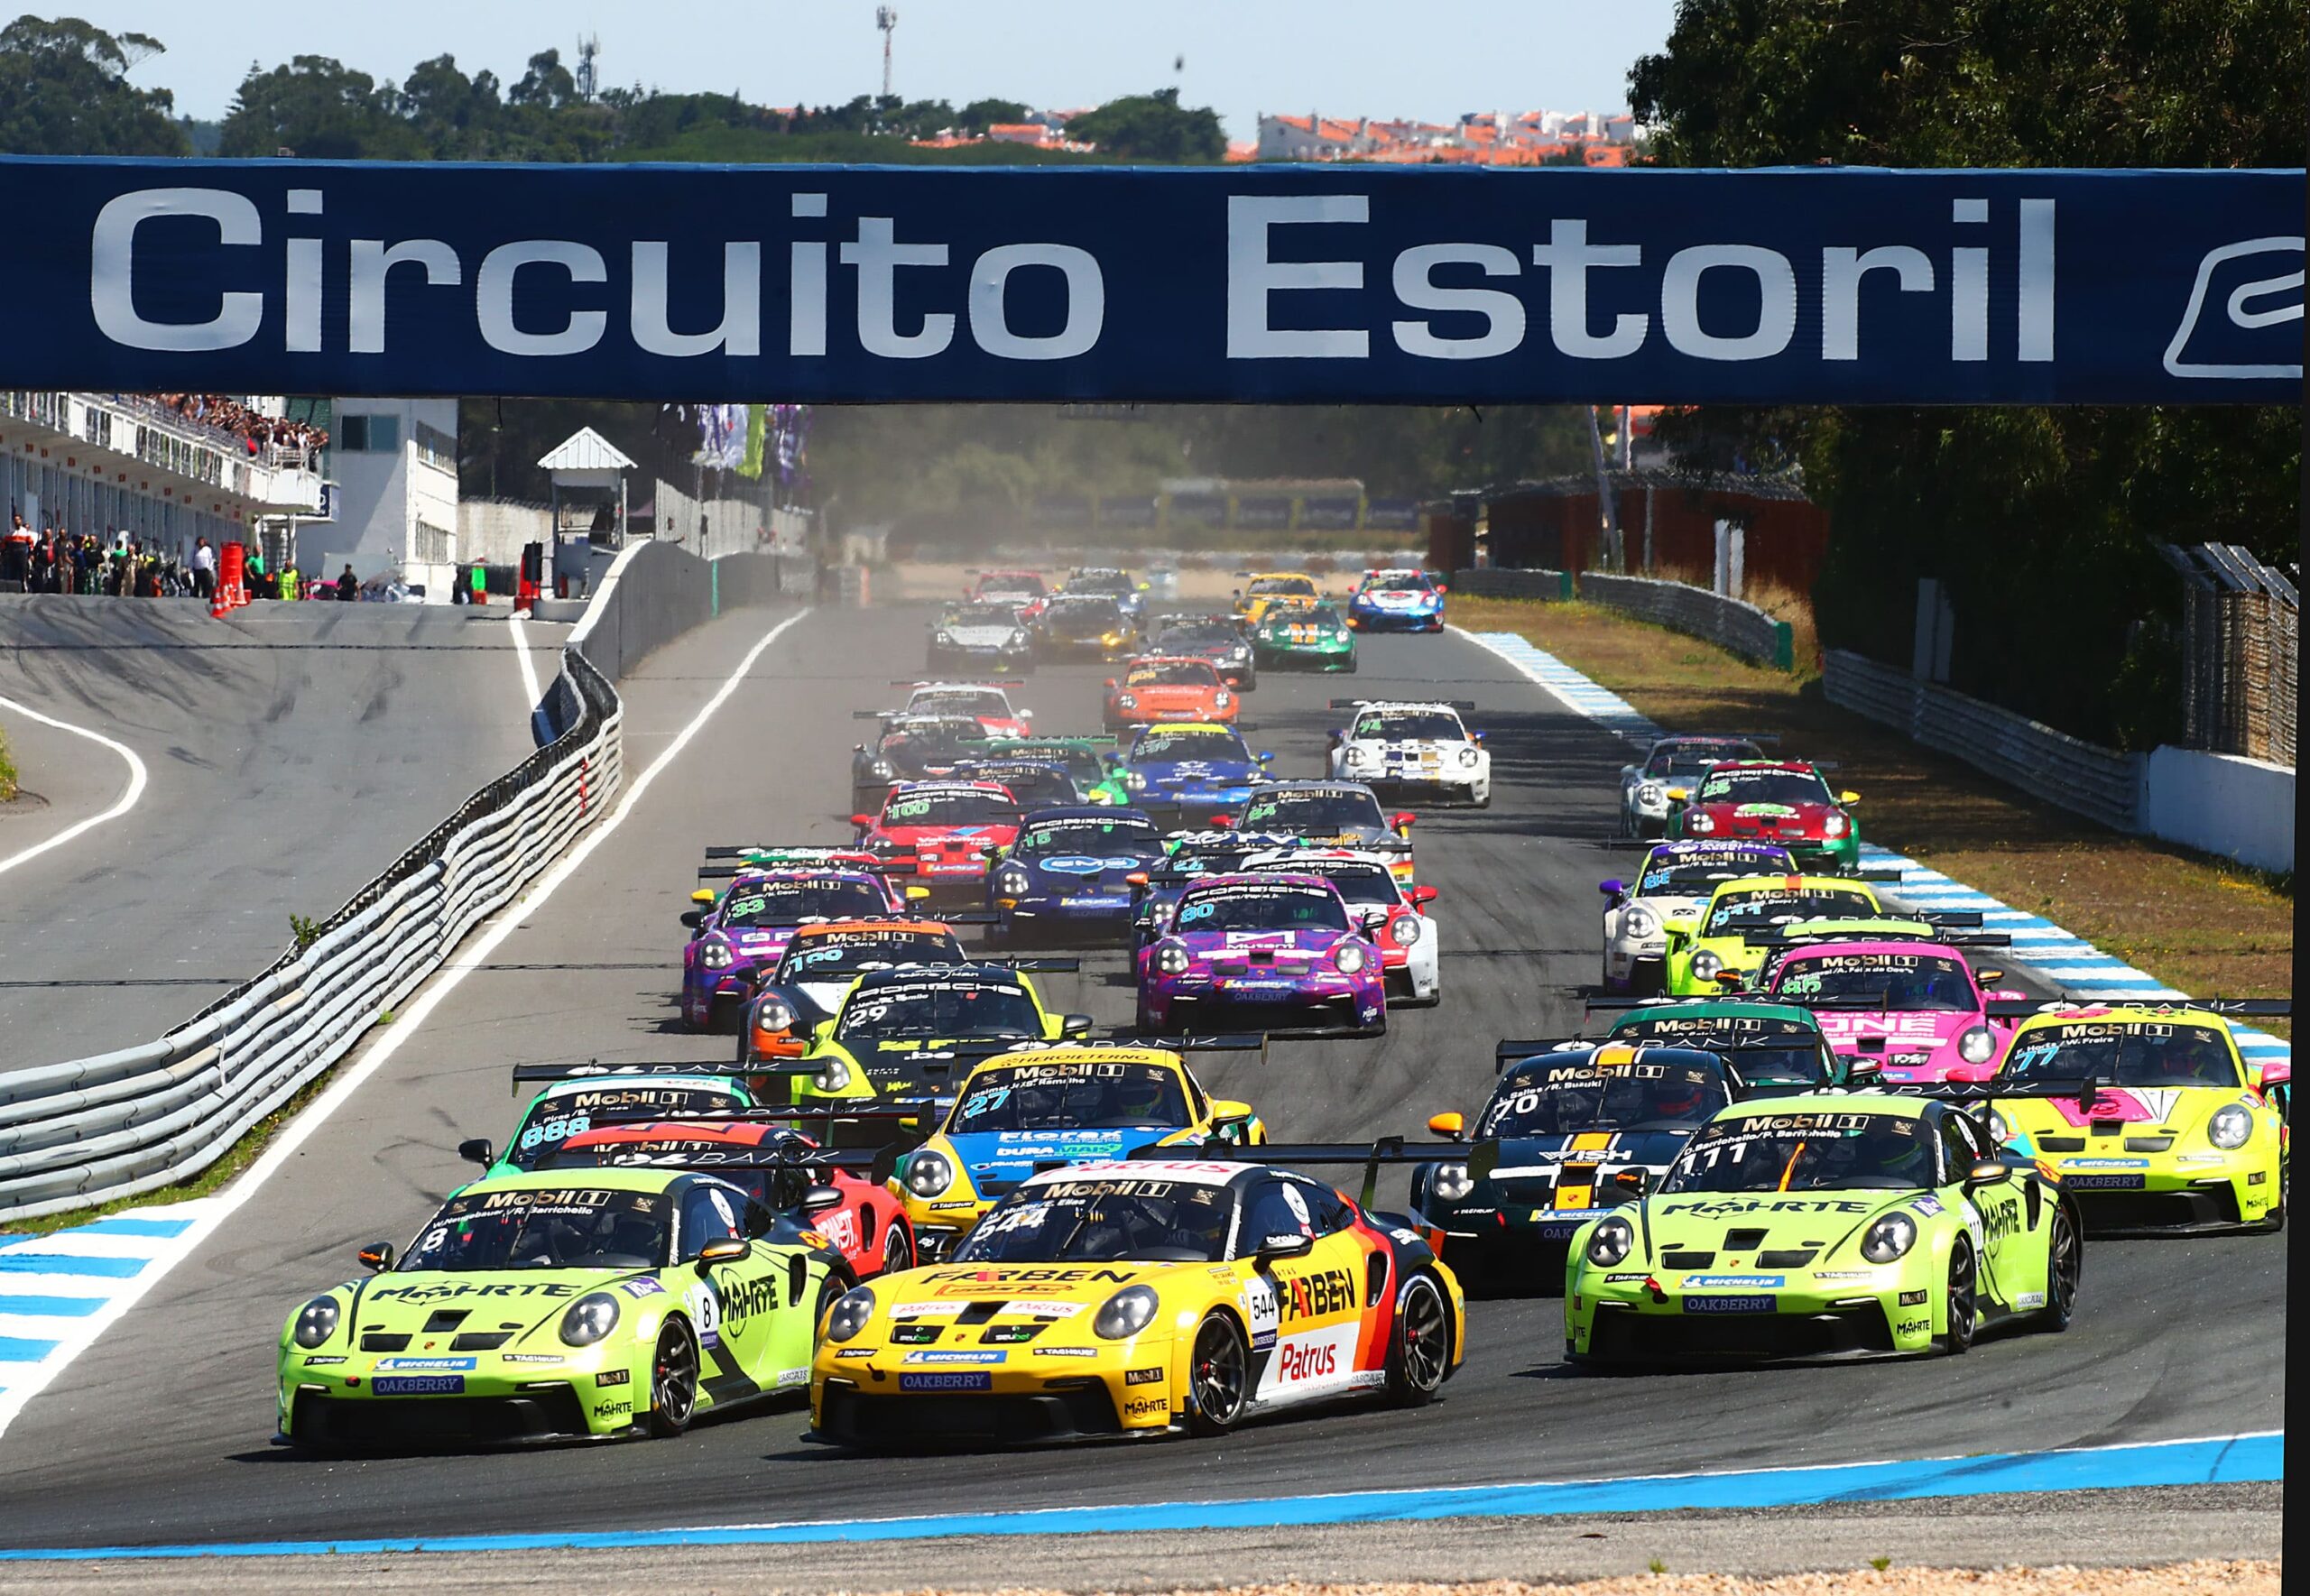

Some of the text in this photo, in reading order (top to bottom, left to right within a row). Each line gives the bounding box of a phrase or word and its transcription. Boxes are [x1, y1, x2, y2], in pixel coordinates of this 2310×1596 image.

[91, 187, 2055, 361] Circuito Estoril
[1678, 852, 1734, 863] Mobil
[762, 880, 818, 892] Mobil
[1751, 889, 1810, 900] Mobil
[730, 898, 766, 918] 33
[1179, 903, 1215, 923] 80
[826, 931, 890, 945] Mobil
[1821, 955, 1891, 969] Mobil
[856, 982, 1022, 1001] PORSCHE
[848, 1005, 887, 1028] 29
[1653, 1018, 1731, 1033] Mobil
[1821, 1018, 1936, 1033] ONE
[2061, 1023, 2142, 1038] Mobil
[2014, 1046, 2061, 1073] 77
[1013, 1063, 1093, 1081] Mobil
[1547, 1066, 1631, 1083] Mobil
[574, 1091, 657, 1108] Mobil
[965, 1089, 1012, 1119] 27
[1492, 1093, 1539, 1124] 70
[1742, 1113, 1834, 1132] Mobil
[519, 1116, 592, 1149] 888
[998, 1130, 1123, 1141] Florax
[996, 1146, 1055, 1158] DURA
[1538, 1149, 1633, 1161] WISH
[1678, 1142, 1748, 1176] 111
[2078, 1159, 2143, 1168] MICHELIN
[1042, 1181, 1138, 1199] Mobil
[2066, 1176, 2141, 1189] OAKBERRY
[483, 1189, 576, 1210] Mobil
[1057, 1197, 1086, 1207] Elias
[971, 1207, 1049, 1242] 544
[420, 1227, 450, 1252] 8
[919, 1269, 1141, 1285] FARBEN
[1702, 1277, 1777, 1287] MICHELIN
[1278, 1268, 1356, 1324] FARBEN
[1687, 1296, 1771, 1312] OAKBERRY
[703, 1296, 712, 1329] 8
[1252, 1290, 1277, 1322] 544
[395, 1358, 469, 1370] MICHELIN
[925, 1352, 999, 1362] MICHELIN
[1279, 1342, 1337, 1384] Patrus
[376, 1377, 459, 1394] OAKBERRY
[903, 1374, 986, 1389] OAKBERRY
